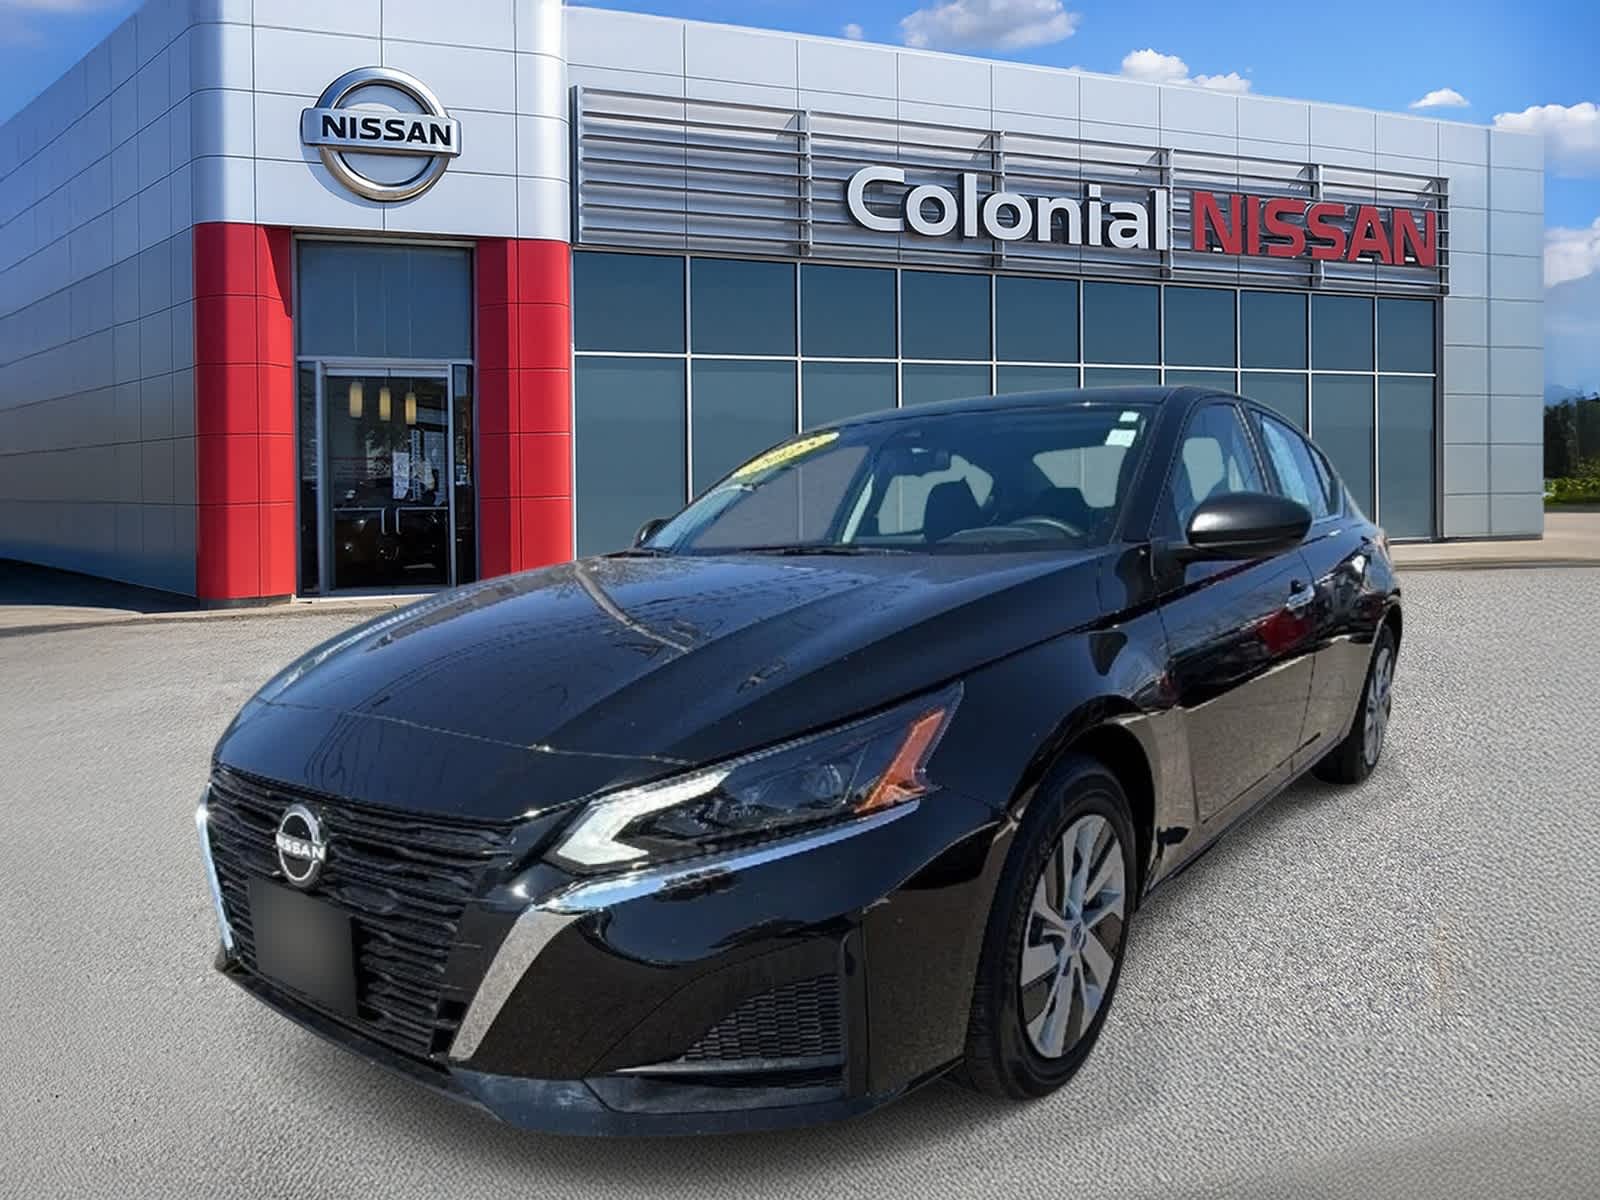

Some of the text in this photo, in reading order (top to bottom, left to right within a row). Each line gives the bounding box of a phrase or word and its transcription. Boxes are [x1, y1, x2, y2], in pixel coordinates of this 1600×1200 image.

[321, 115, 452, 146] NISSAN
[848, 166, 1436, 266] Colonial NISSAN
